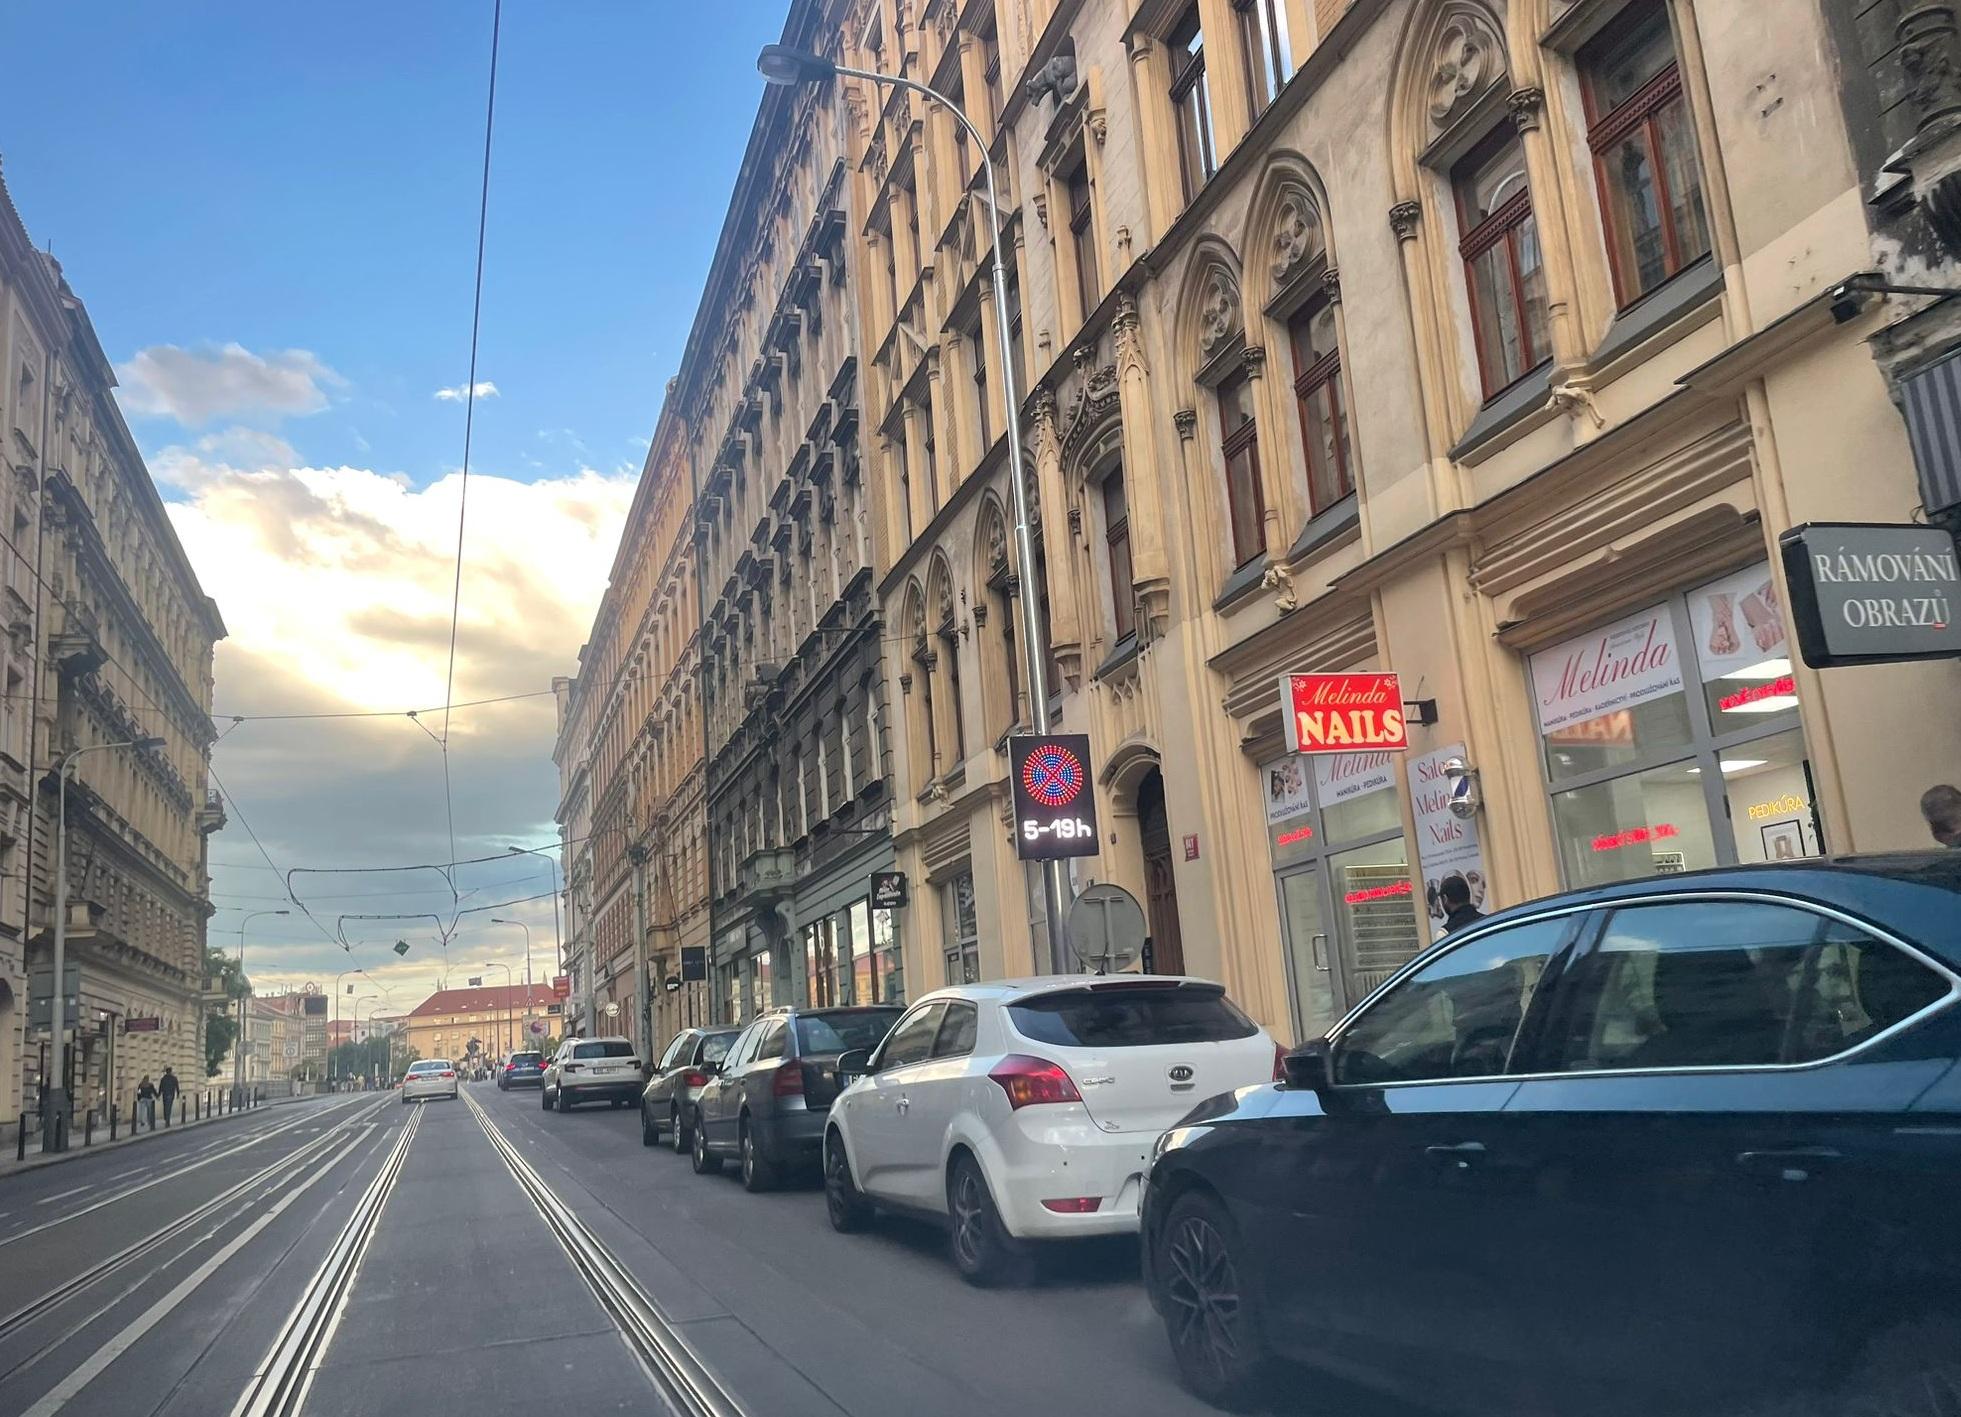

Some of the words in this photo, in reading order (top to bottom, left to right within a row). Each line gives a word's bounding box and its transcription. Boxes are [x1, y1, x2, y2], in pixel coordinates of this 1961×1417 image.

[1814, 546, 1957, 582] RÁMOVÁNÍ
[1843, 589, 1951, 628] OBRAZŮ
[1544, 619, 1670, 706] Melinda
[1302, 679, 1387, 705] Melinda
[1297, 709, 1404, 746] NAILS
[1416, 790, 1450, 816] Melin
[1748, 794, 1805, 820] PEDIKÚRA
[1023, 818, 1092, 840] 5-19h
[1429, 820, 1463, 845] Nails
